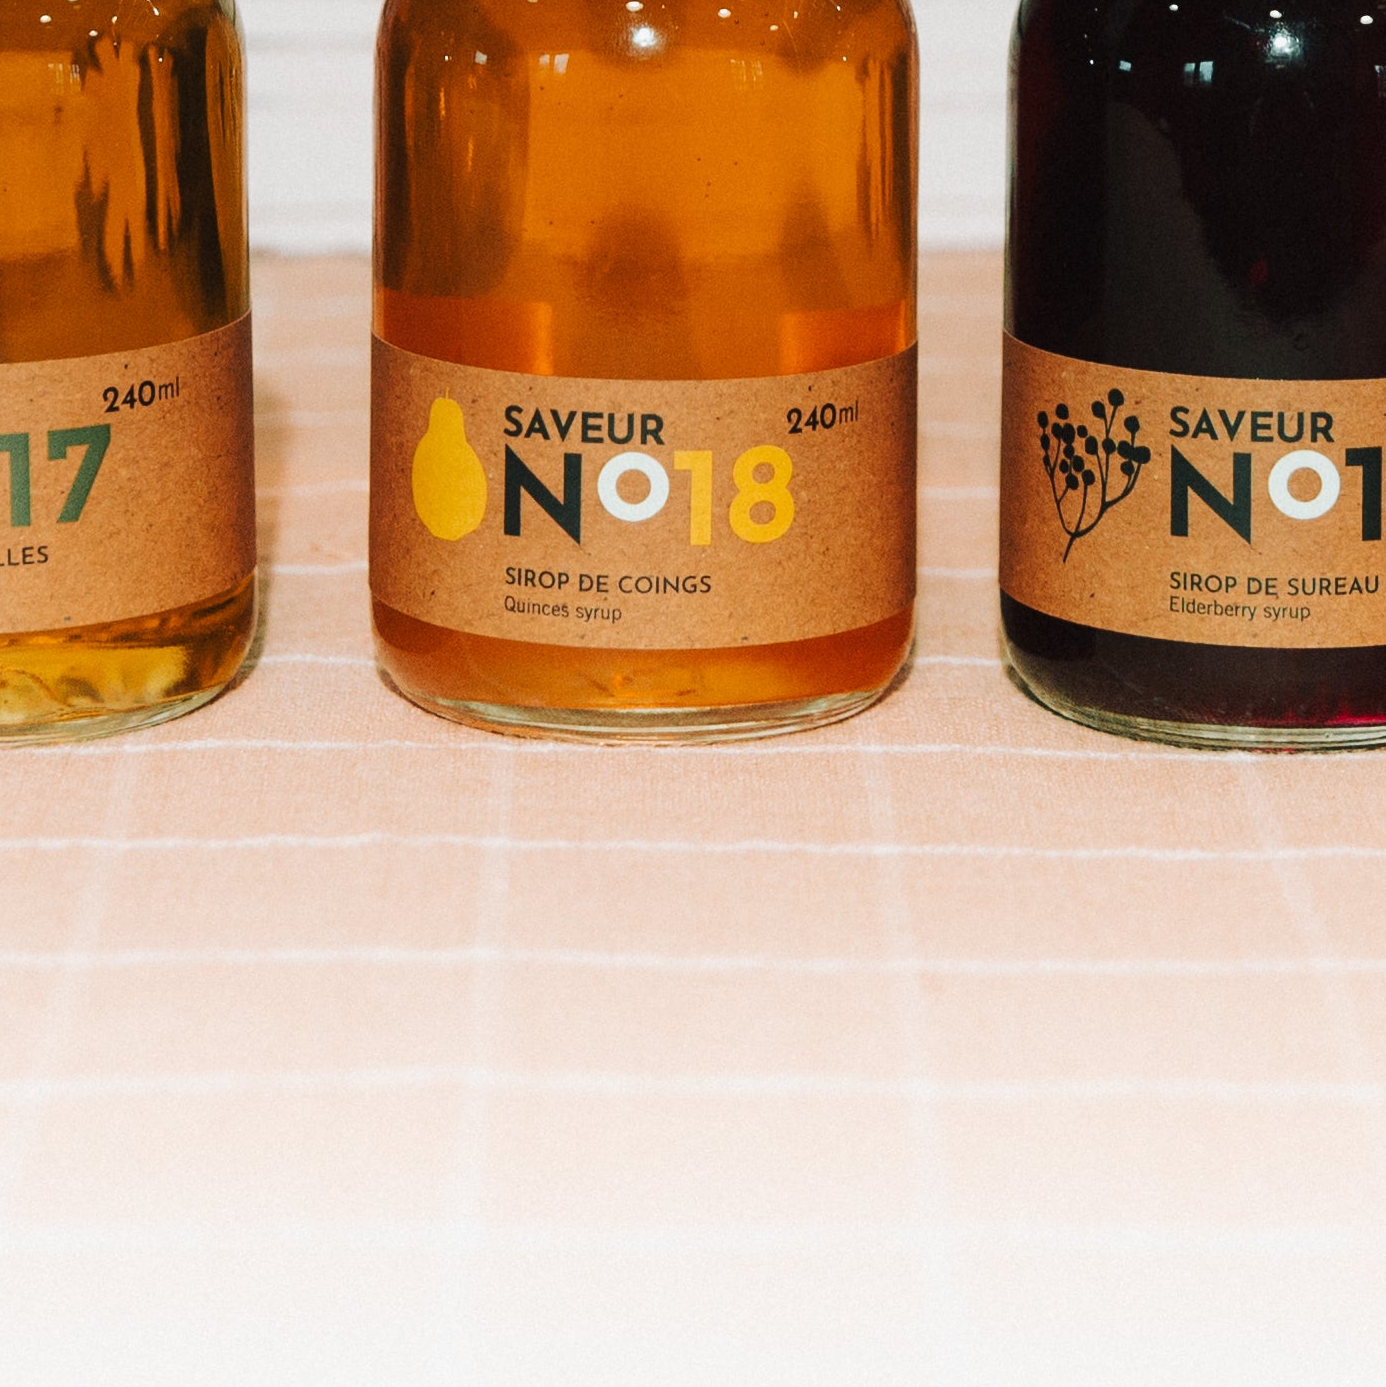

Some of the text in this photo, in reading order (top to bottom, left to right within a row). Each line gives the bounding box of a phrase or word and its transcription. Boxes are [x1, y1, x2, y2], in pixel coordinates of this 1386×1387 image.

[102, 376, 181, 413] 240ml
[503, 405, 664, 445] SAVEUR
[787, 400, 859, 433] 240ml
[1169, 406, 1335, 443] SAVEUR
[505, 567, 711, 594] SIROP DE COINGS
[1169, 572, 1380, 596] SIROP DE SUREAU
[504, 596, 622, 622] Quinces syrup
[1169, 596, 1310, 621] Elderberry syrup
